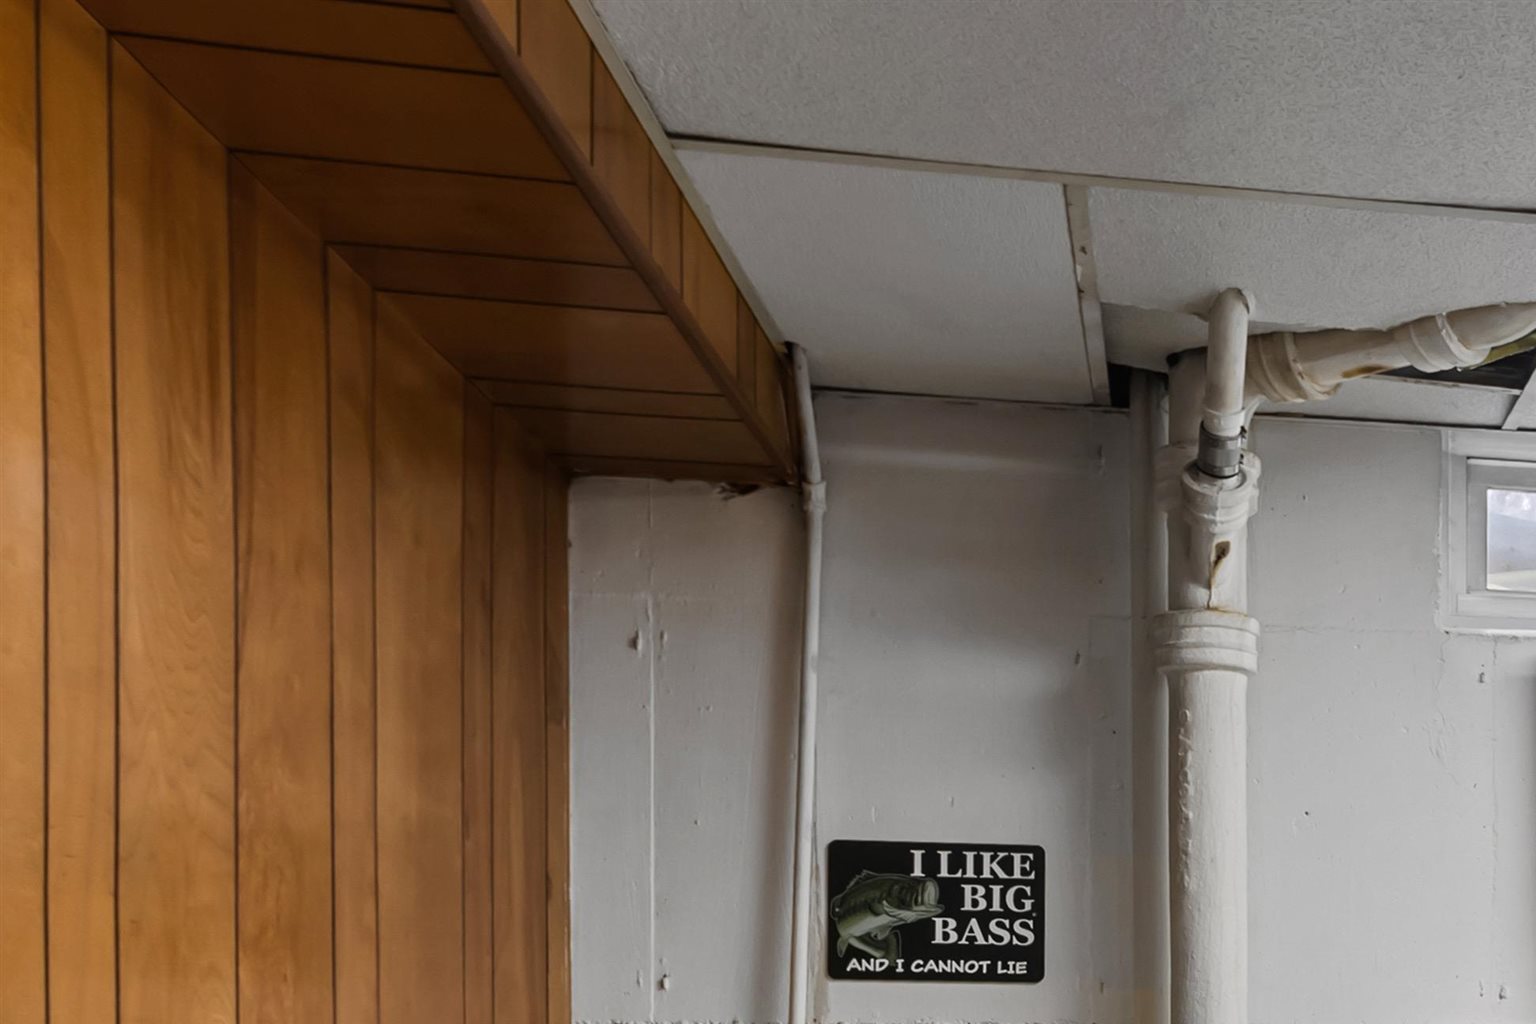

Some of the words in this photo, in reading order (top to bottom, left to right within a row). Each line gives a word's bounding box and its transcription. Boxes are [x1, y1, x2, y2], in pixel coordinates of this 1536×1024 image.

[910, 849, 926, 877] I
[937, 850, 1036, 879] LIKE
[960, 884, 1035, 913] BIG
[931, 917, 1036, 947] BASS
[846, 957, 890, 972] AND
[896, 959, 905, 973] I
[911, 959, 991, 974] CANNOT
[997, 960, 1028, 975] LIE
